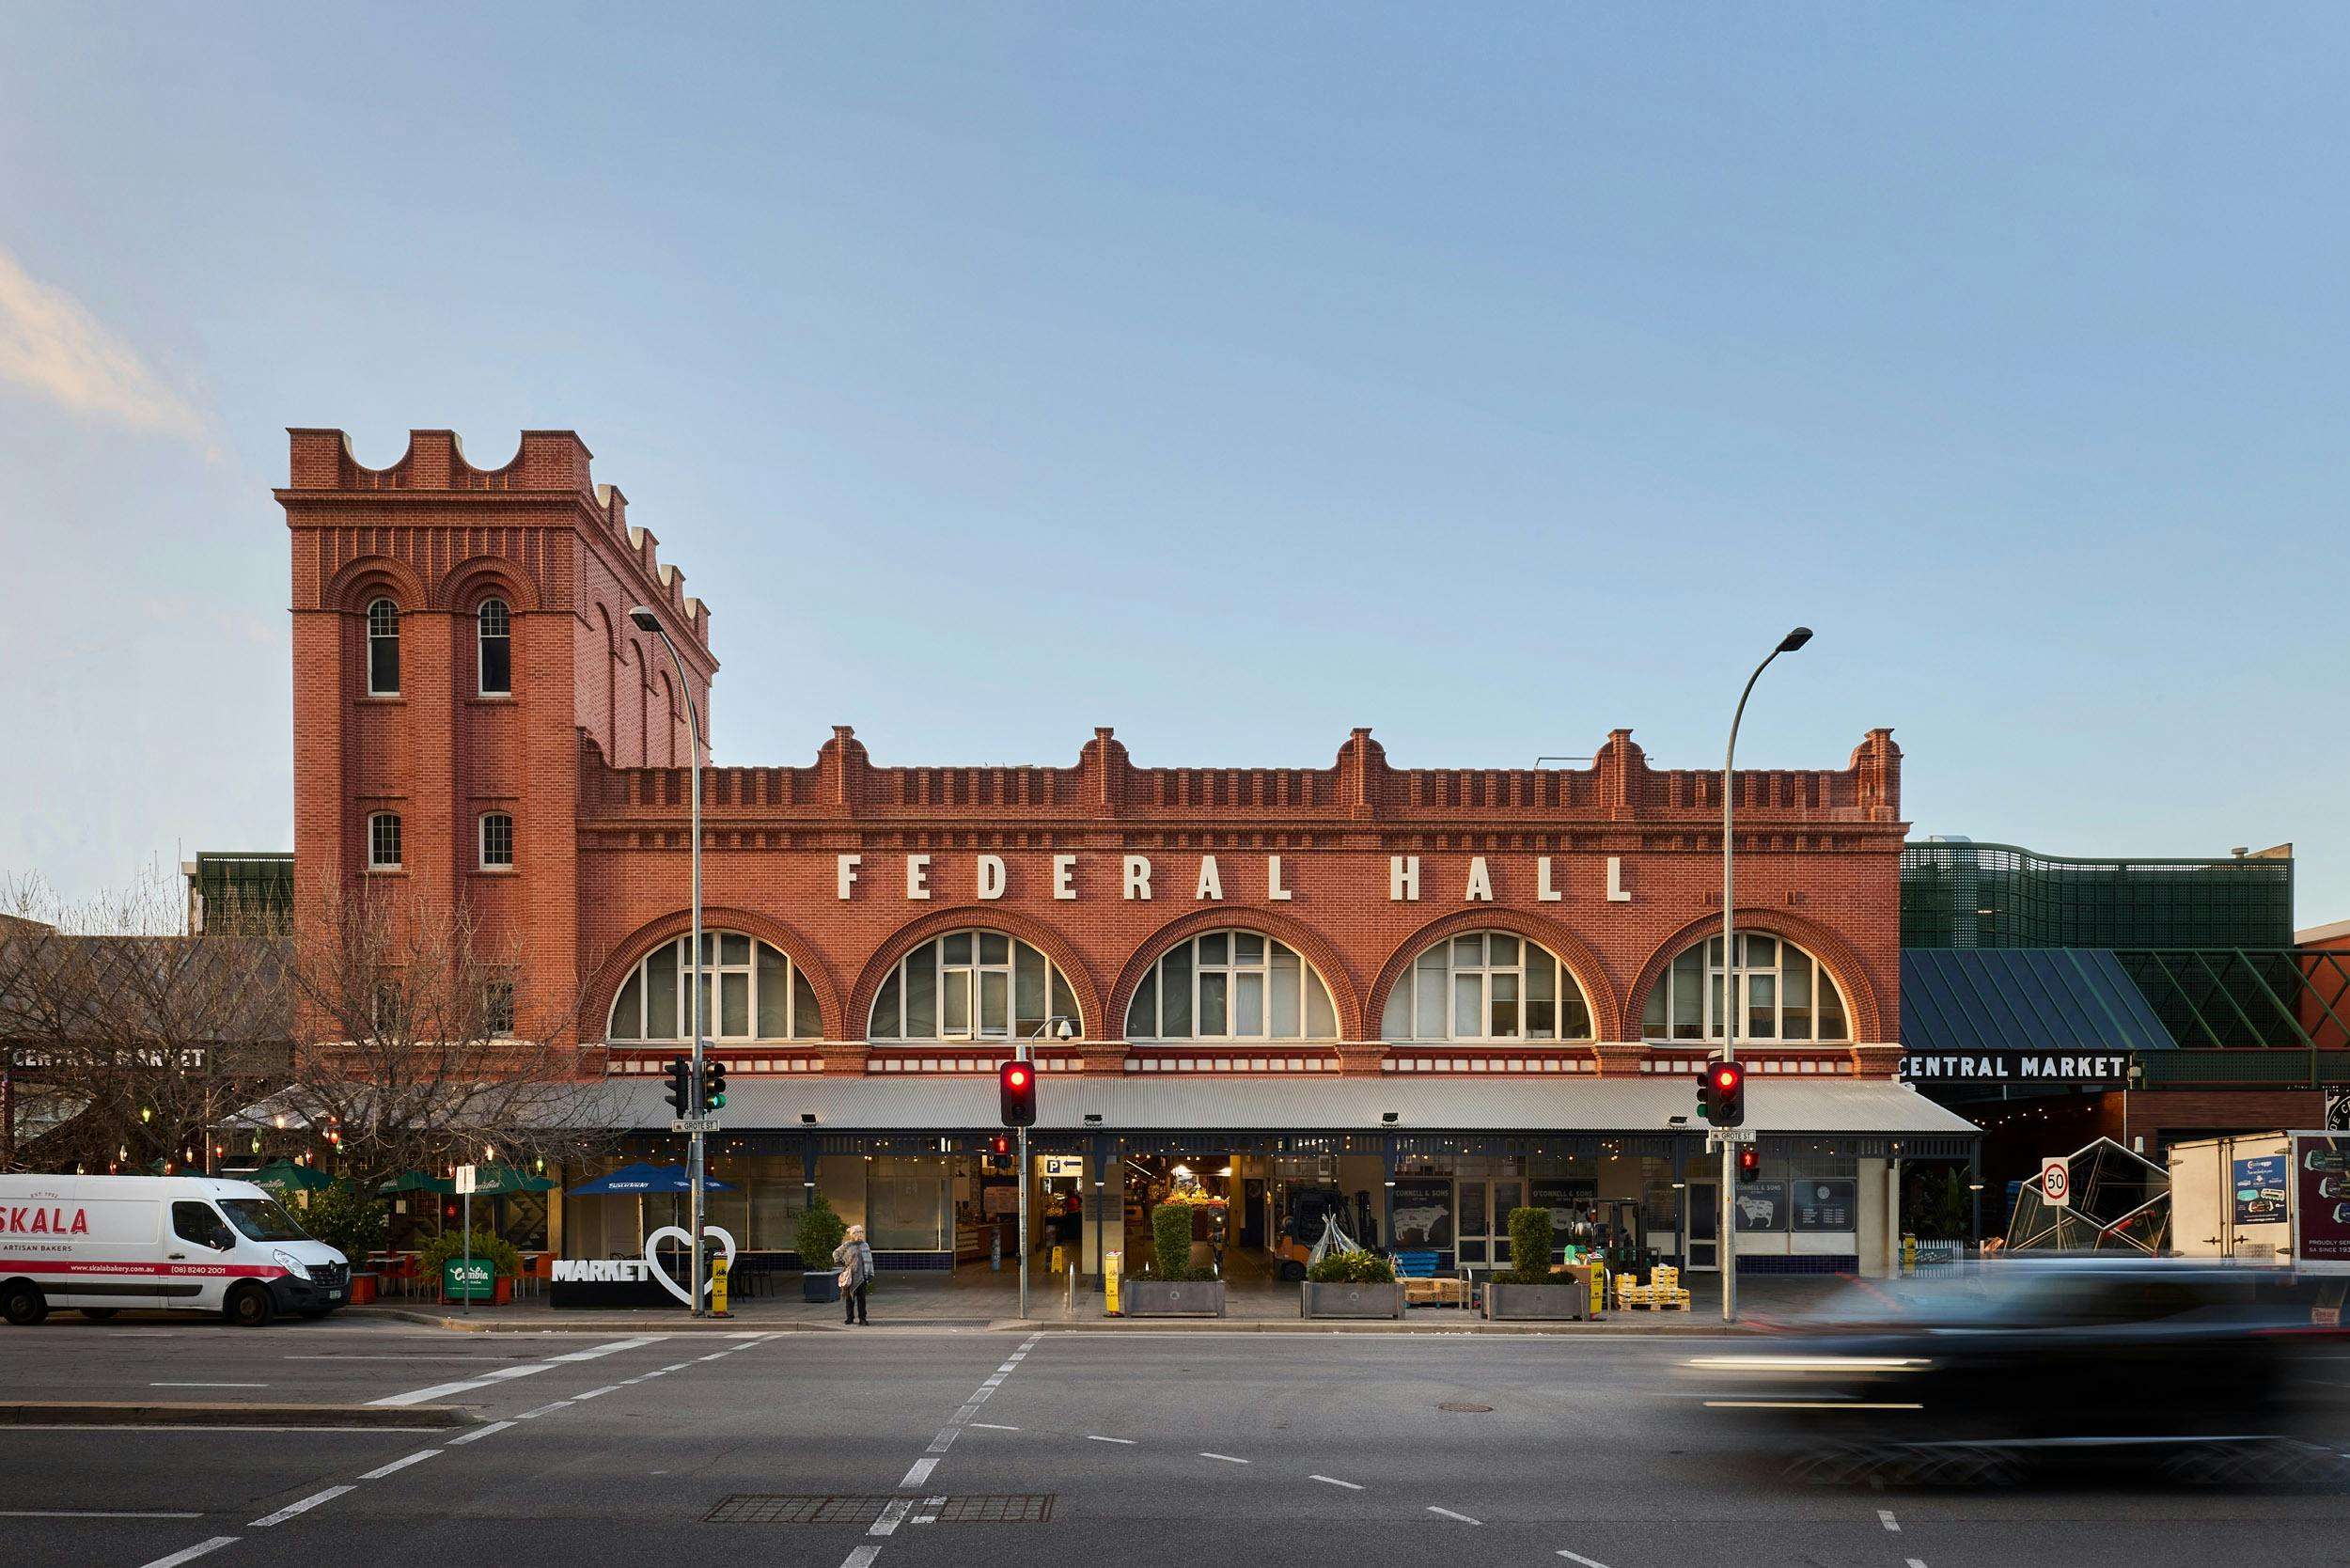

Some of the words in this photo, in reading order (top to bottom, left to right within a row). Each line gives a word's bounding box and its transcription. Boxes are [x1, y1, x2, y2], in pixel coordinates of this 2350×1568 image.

[838, 855, 1292, 900] FEDERAL
[1390, 856, 1631, 902] HALL
[1899, 1057, 2009, 1076] CENTRAL
[2021, 1057, 2124, 1077] MARKET
[684, 1121, 705, 1130] GROTE
[1050, 1161, 1058, 1172] P
[2048, 1174, 2064, 1189] 50
[70, 1264, 155, 1274] www.skalabakery.com.au
[552, 1260, 650, 1281] MARKET
